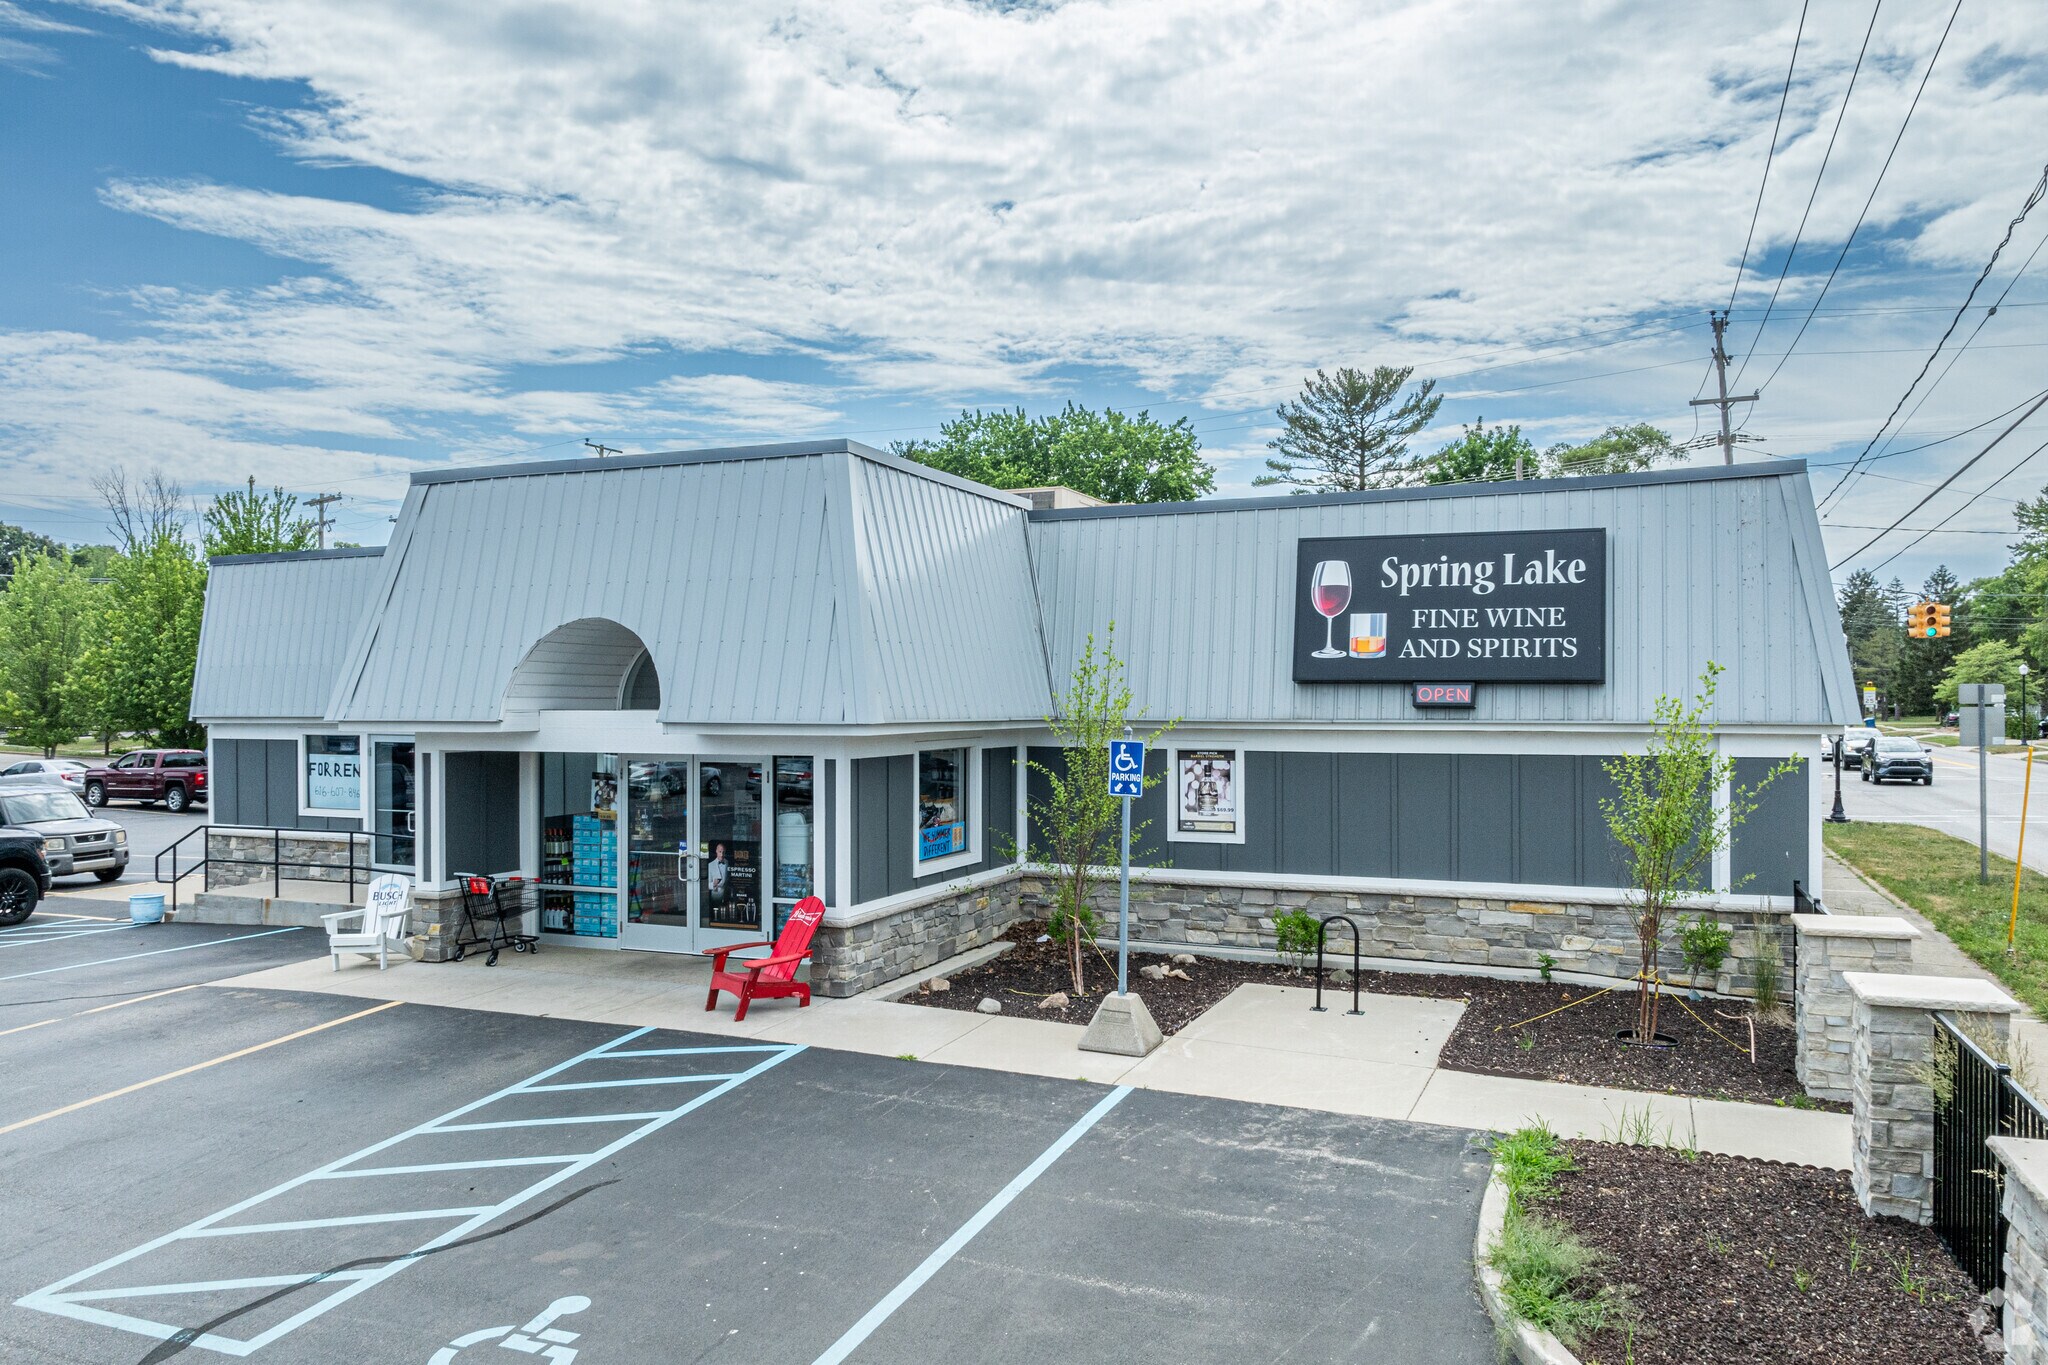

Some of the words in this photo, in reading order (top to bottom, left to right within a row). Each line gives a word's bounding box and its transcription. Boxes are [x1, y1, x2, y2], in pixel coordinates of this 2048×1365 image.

[1381, 555, 1496, 597] Spring
[1503, 549, 1587, 586] Lake
[1412, 608, 1479, 629] FINE
[1485, 606, 1567, 628] WINE
[1398, 638, 1461, 659] AND
[1467, 636, 1578, 659] SPIRITS
[1418, 687, 1470, 702] OPEN
[309, 762, 333, 777] FOR
[1111, 772, 1141, 782] PARKING
[923, 840, 951, 857] DIFFERENT
[373, 891, 404, 901] BUSCH
